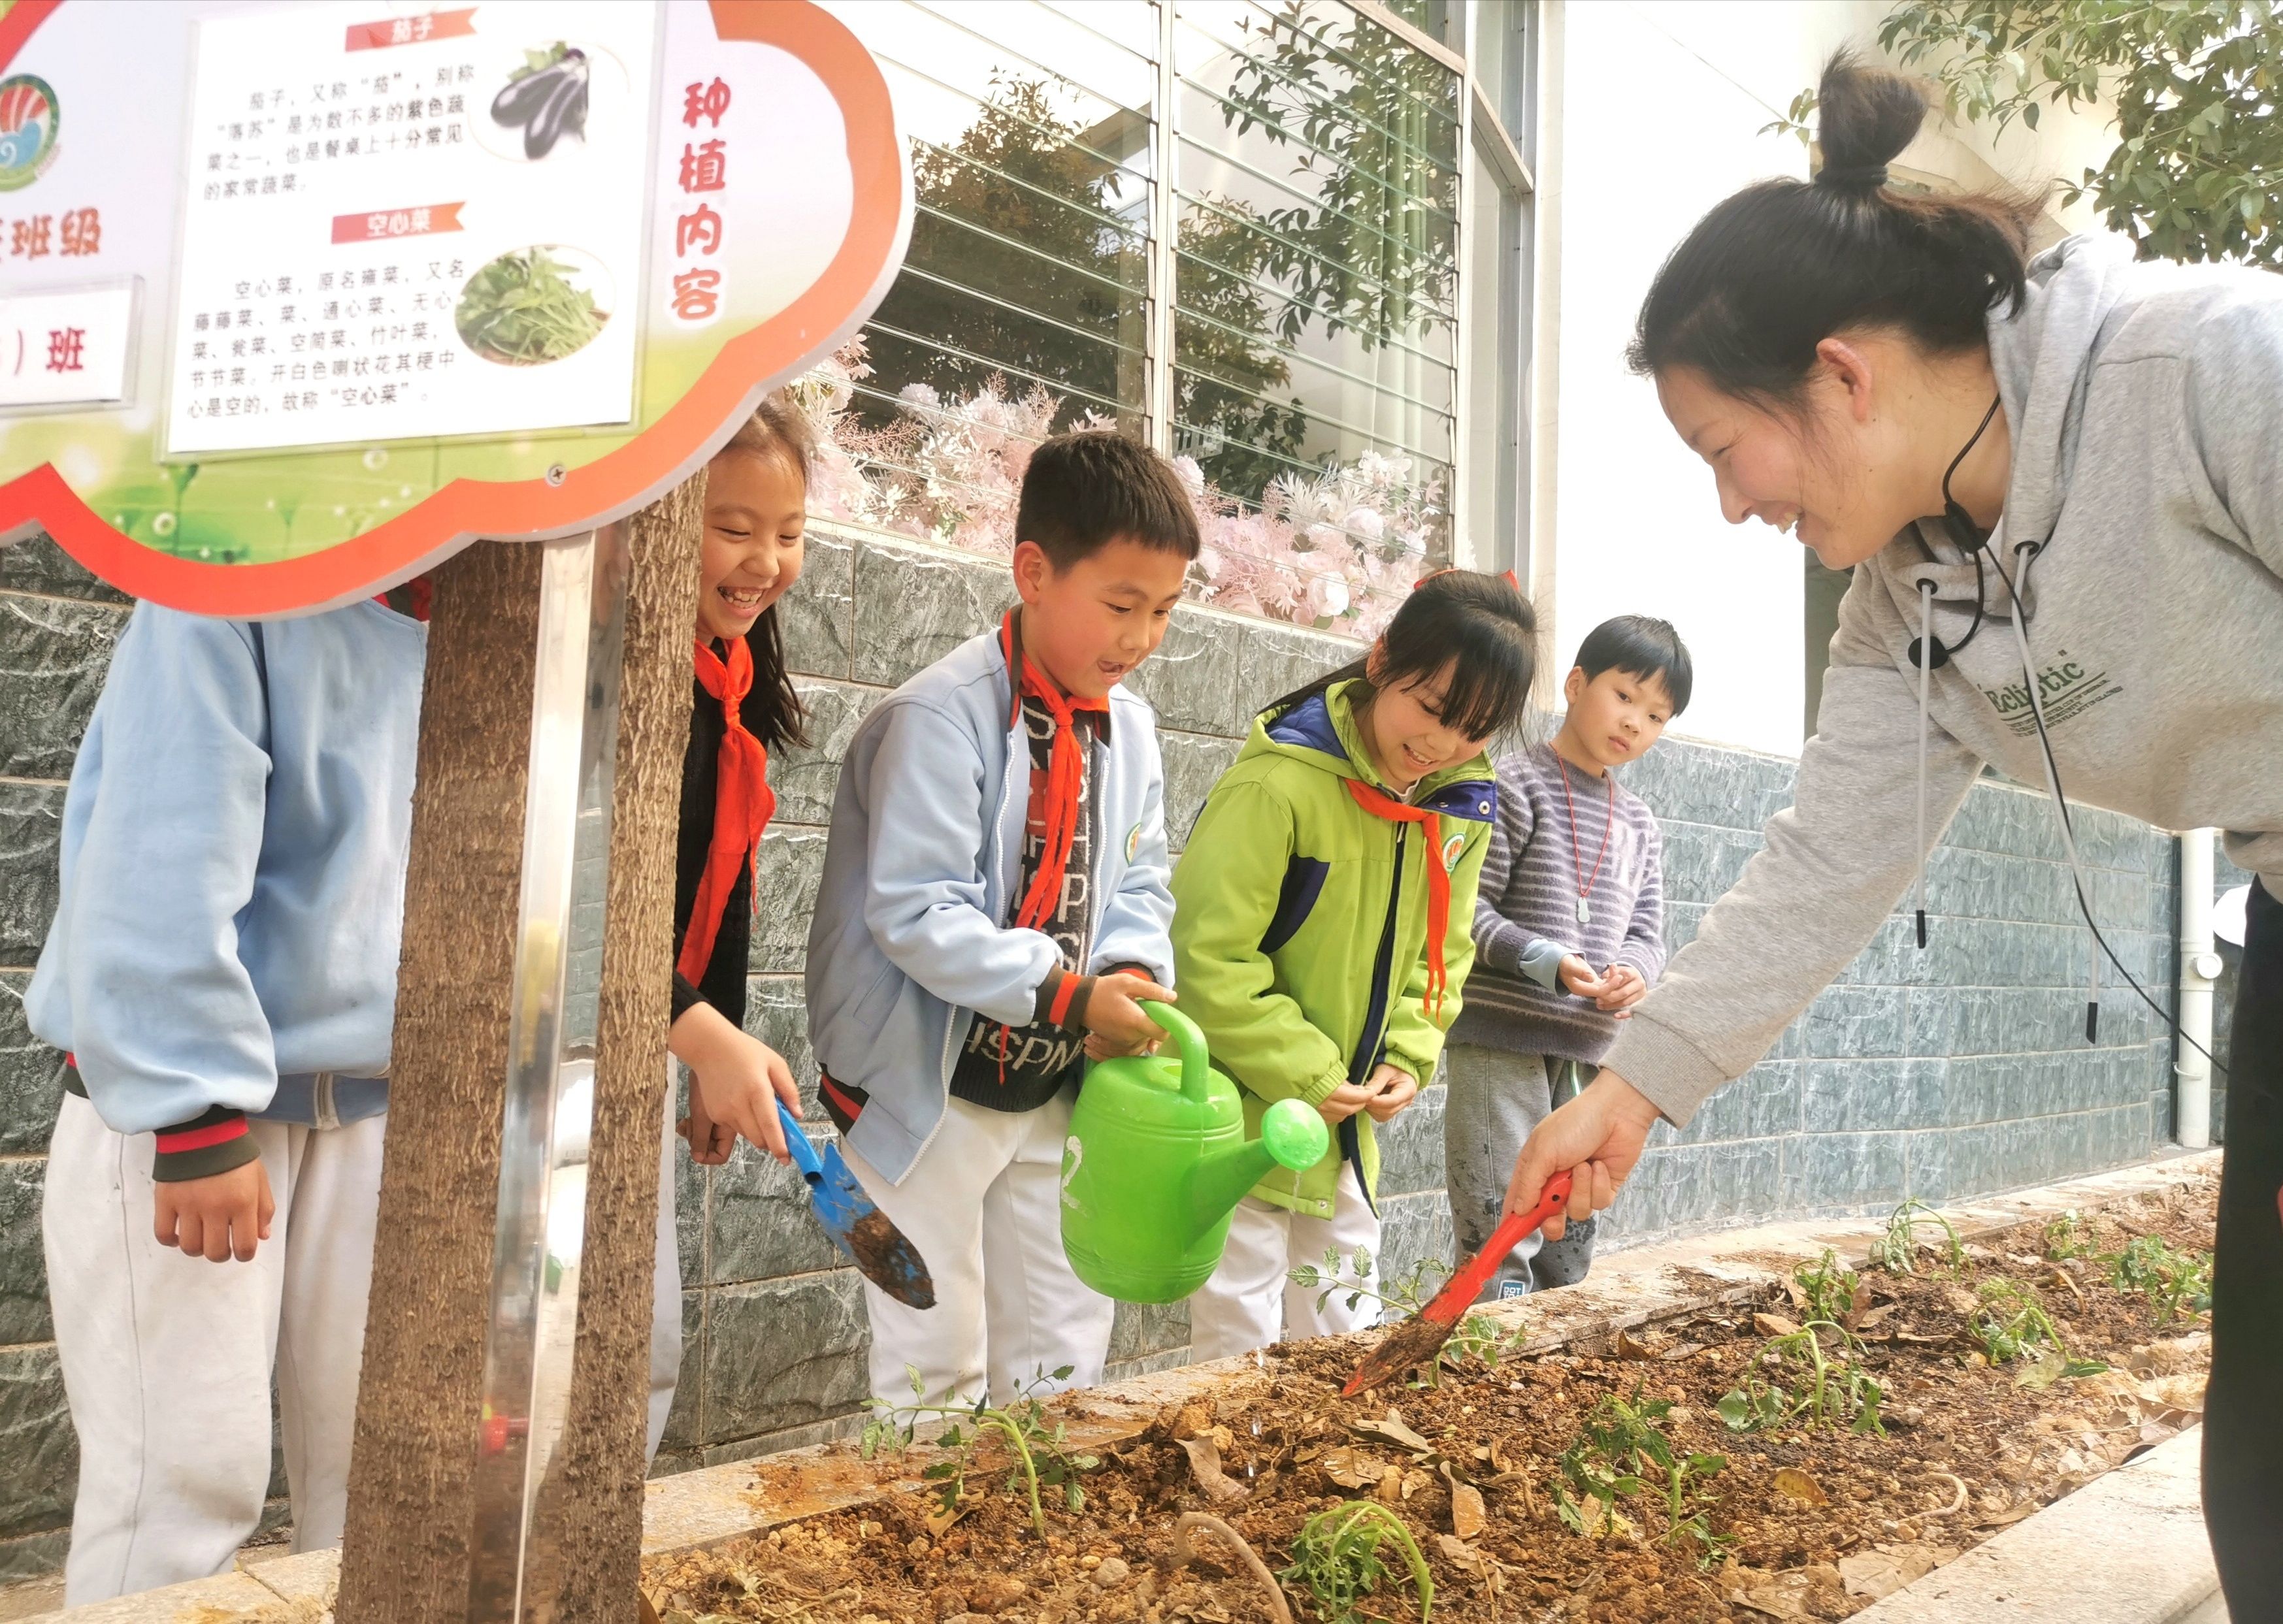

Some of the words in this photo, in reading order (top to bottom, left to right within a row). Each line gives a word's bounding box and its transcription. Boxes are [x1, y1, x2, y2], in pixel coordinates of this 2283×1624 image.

[392, 15, 433, 44] 茄子
[367, 208, 431, 238] 空心菜
[671, 76, 731, 321] 种植内容
[0, 207, 101, 261] 班级
[1060, 1135, 1087, 1216] 2
